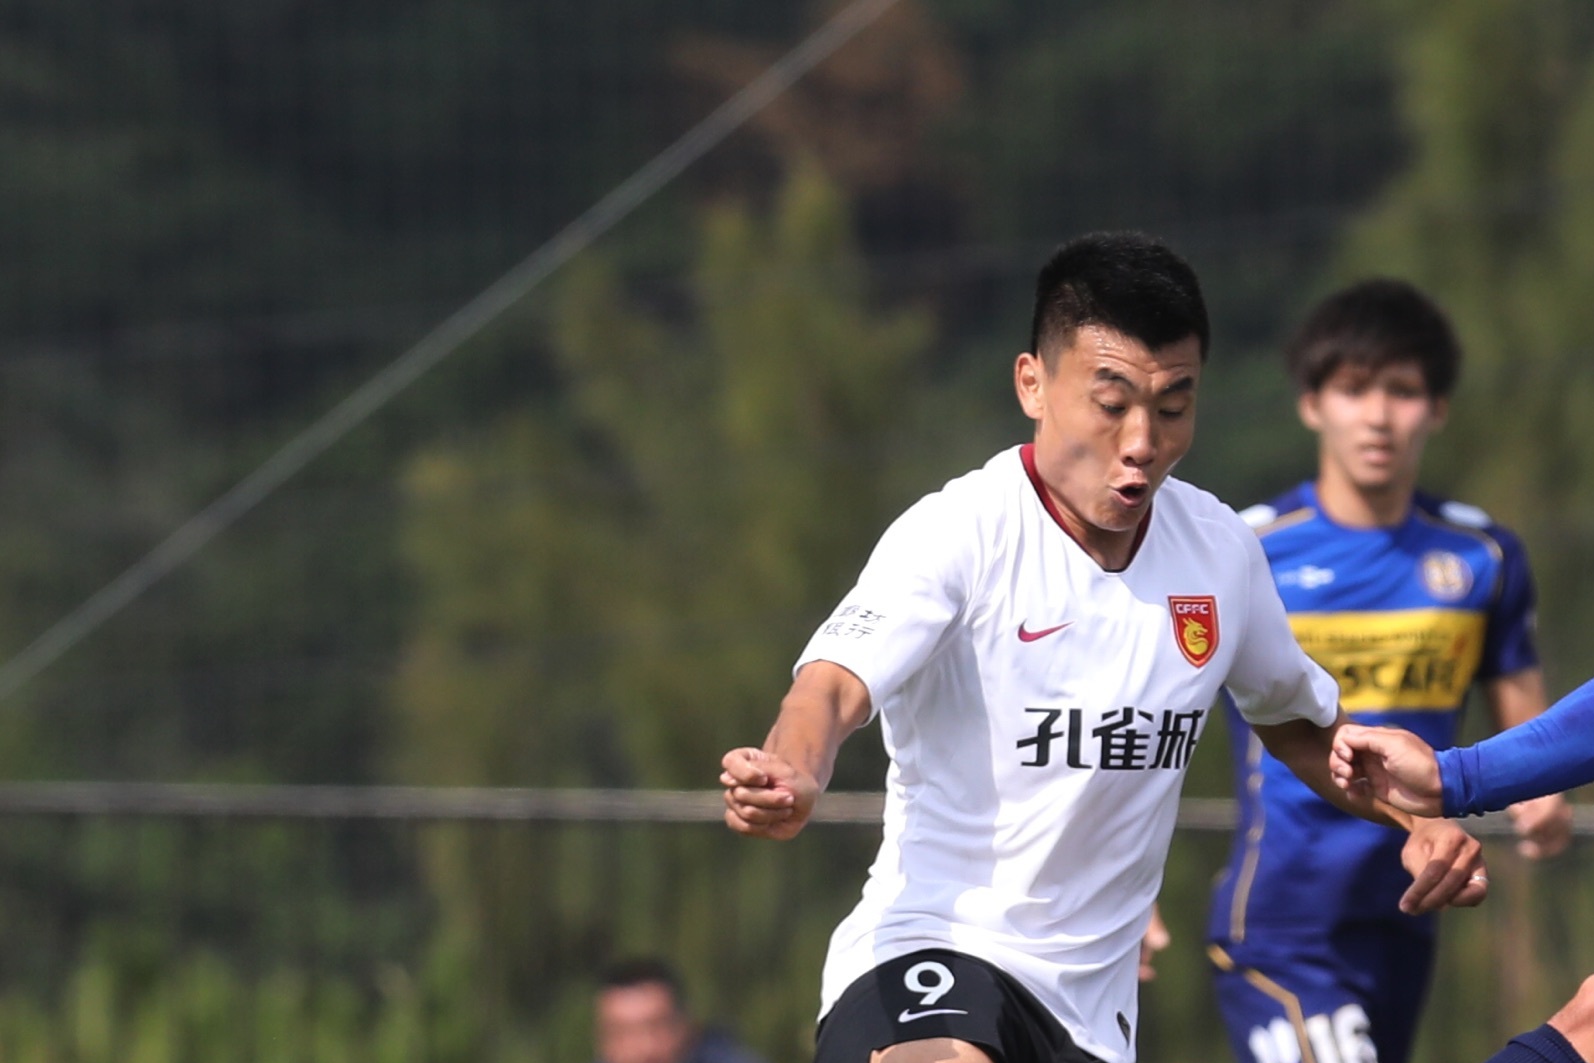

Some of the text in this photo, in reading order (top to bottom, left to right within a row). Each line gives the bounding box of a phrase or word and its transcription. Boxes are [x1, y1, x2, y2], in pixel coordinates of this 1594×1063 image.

[1016, 707, 1205, 770] 孔雀城
[903, 960, 955, 1006] 9
